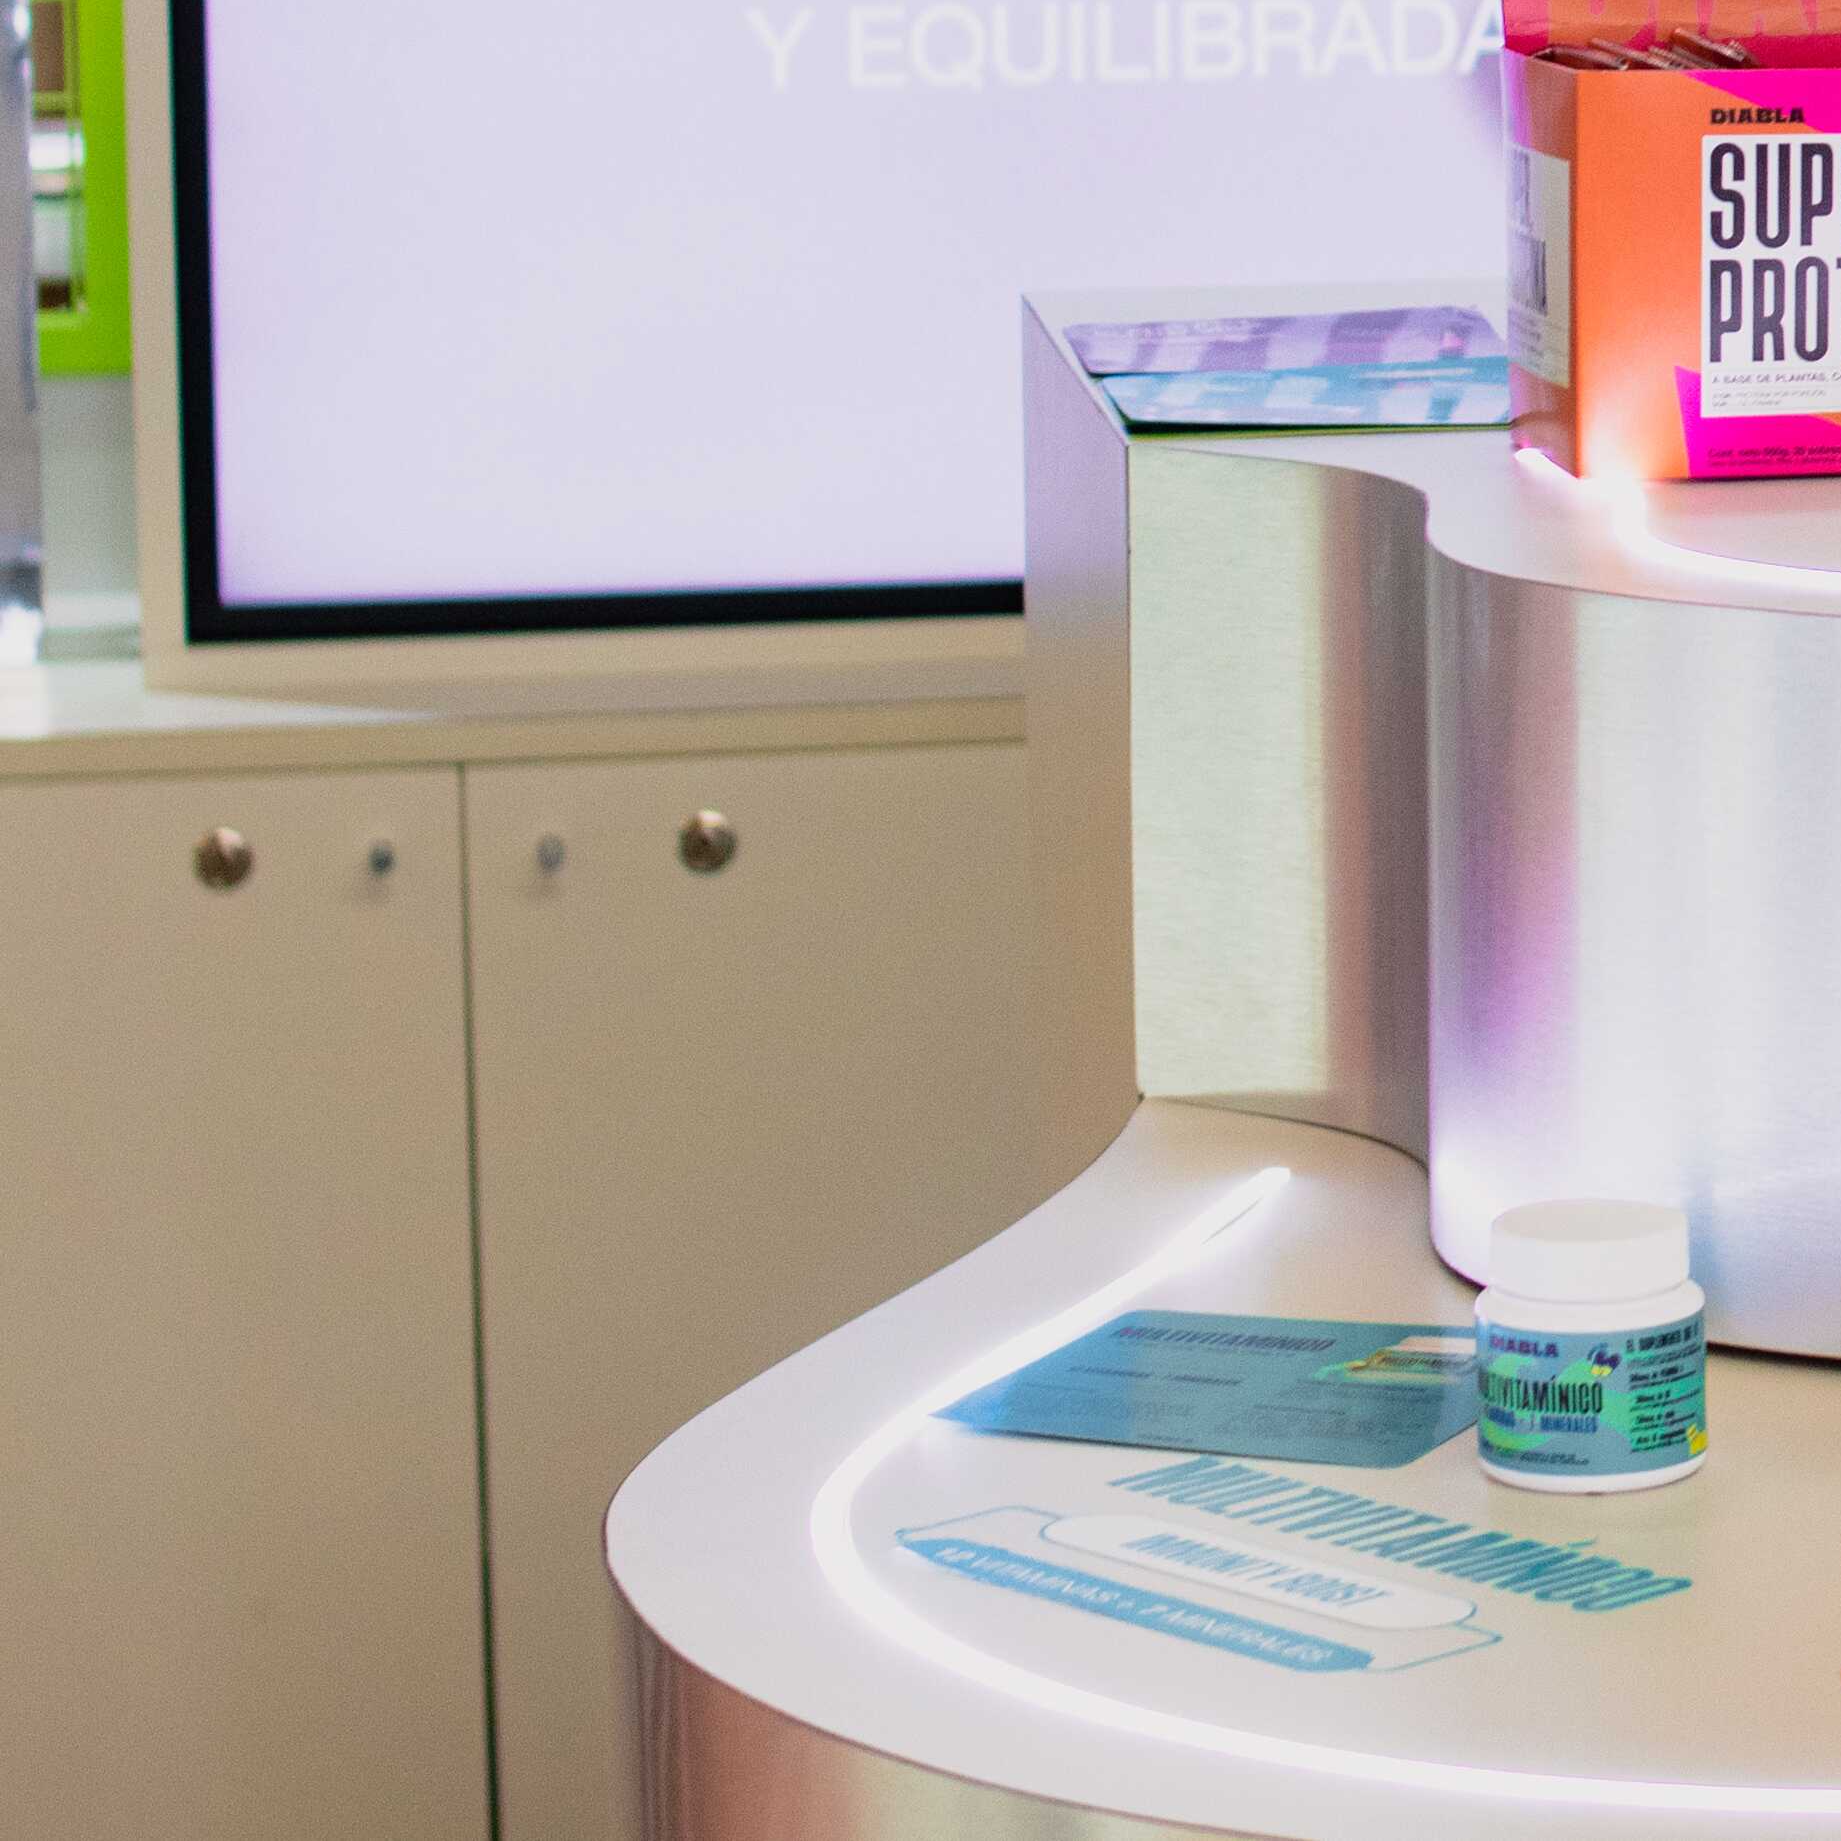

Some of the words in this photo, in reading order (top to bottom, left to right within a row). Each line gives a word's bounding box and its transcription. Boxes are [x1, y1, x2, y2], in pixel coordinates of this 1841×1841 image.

[746, 11, 814, 90] Y
[1709, 106, 1805, 126] DIABLA
[1489, 1335, 1559, 1358] DIABLA
[1106, 1458, 1694, 1612] MULTIVITAMÍNICO
